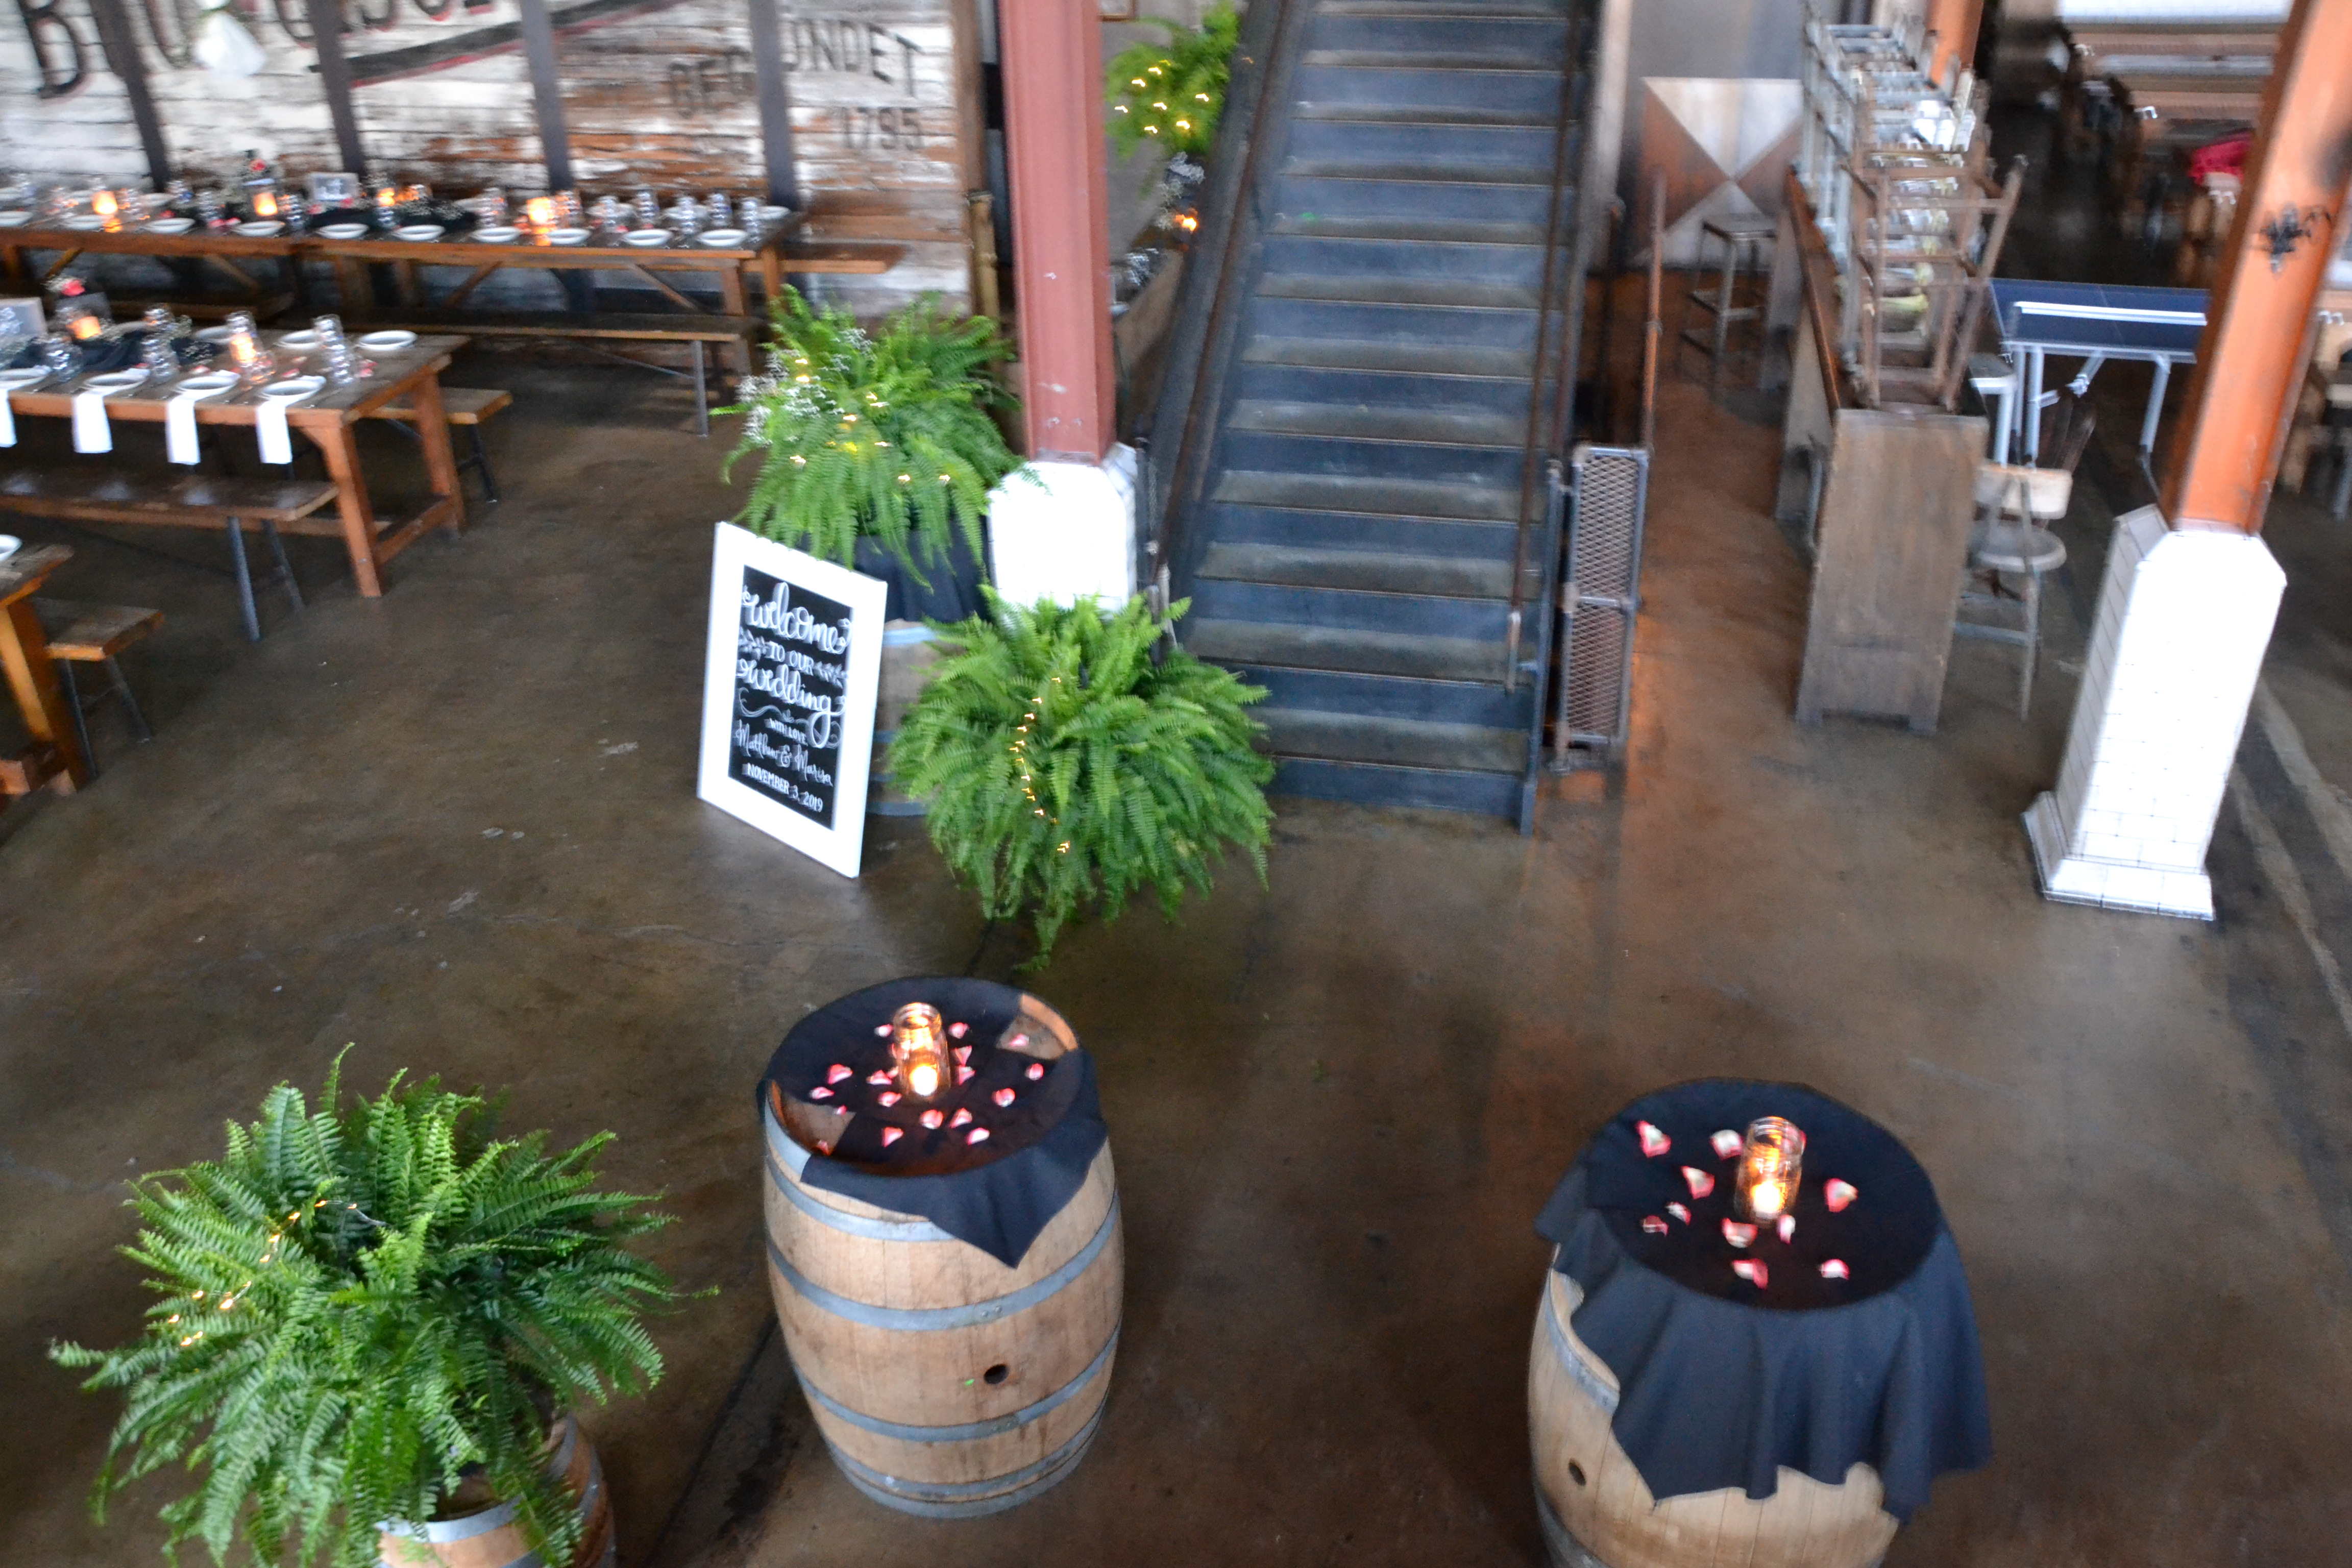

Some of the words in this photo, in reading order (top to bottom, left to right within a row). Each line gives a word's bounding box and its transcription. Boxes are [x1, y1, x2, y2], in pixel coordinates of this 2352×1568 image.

[767, 641, 786, 663] TO
[787, 650, 814, 676] OUR
[744, 763, 790, 795] NOVEMBER
[799, 791, 823, 812] 2019
